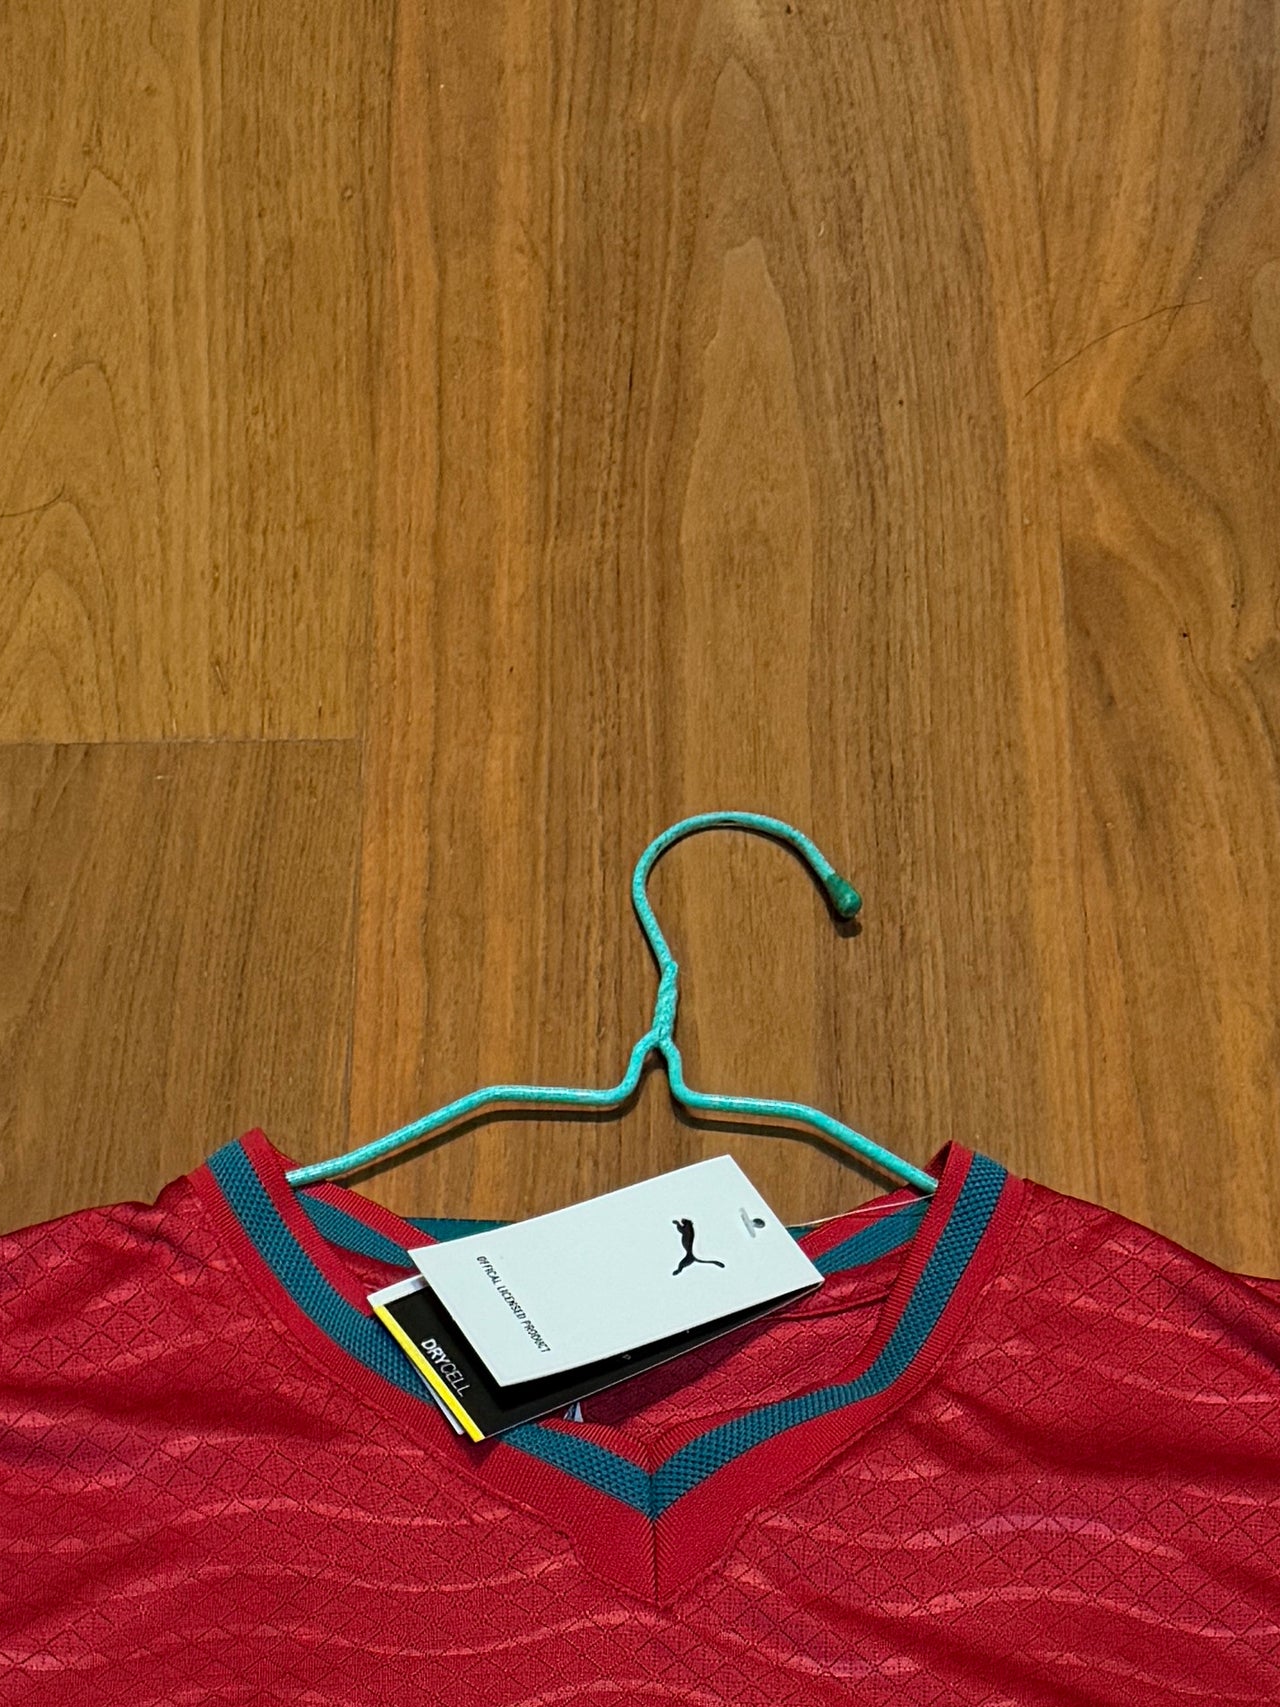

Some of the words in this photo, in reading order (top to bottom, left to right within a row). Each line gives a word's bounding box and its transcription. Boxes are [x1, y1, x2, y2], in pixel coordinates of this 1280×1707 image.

[496, 1285, 527, 1320] LICENSED
[520, 1319, 551, 1353] PRODUCT
[421, 1338, 471, 1398] DRYCELL
